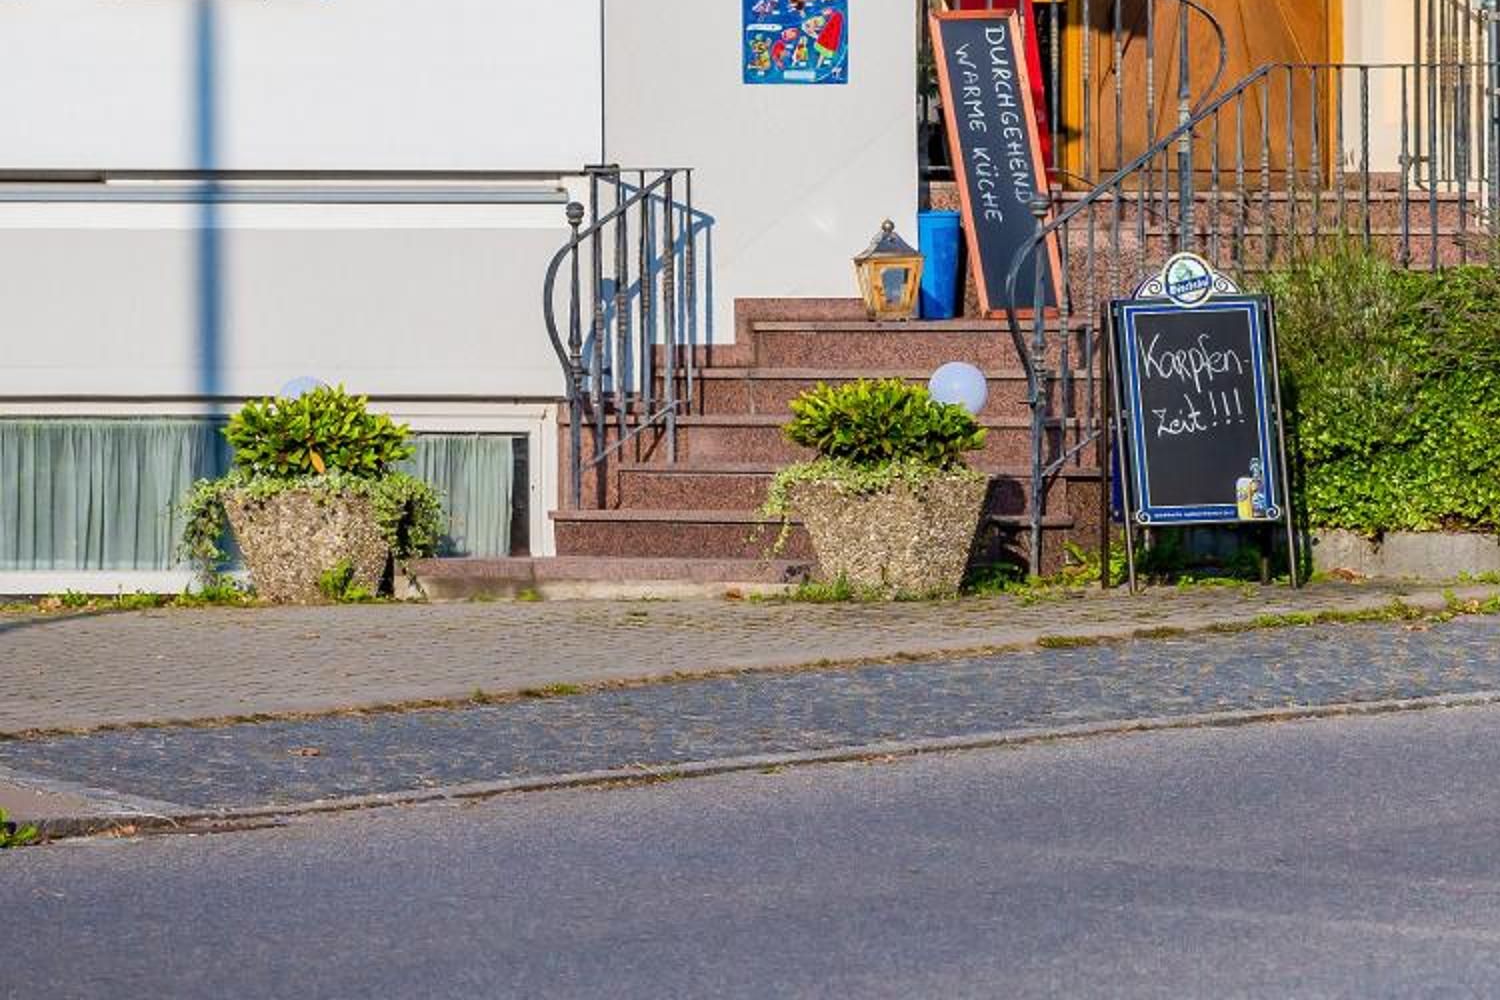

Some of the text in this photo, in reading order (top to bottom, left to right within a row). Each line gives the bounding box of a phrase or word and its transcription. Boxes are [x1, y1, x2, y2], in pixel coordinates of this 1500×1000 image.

[955, 43, 1003, 224] WARME KÜCHE
[984, 25, 1034, 205] DURCHGEHEND
